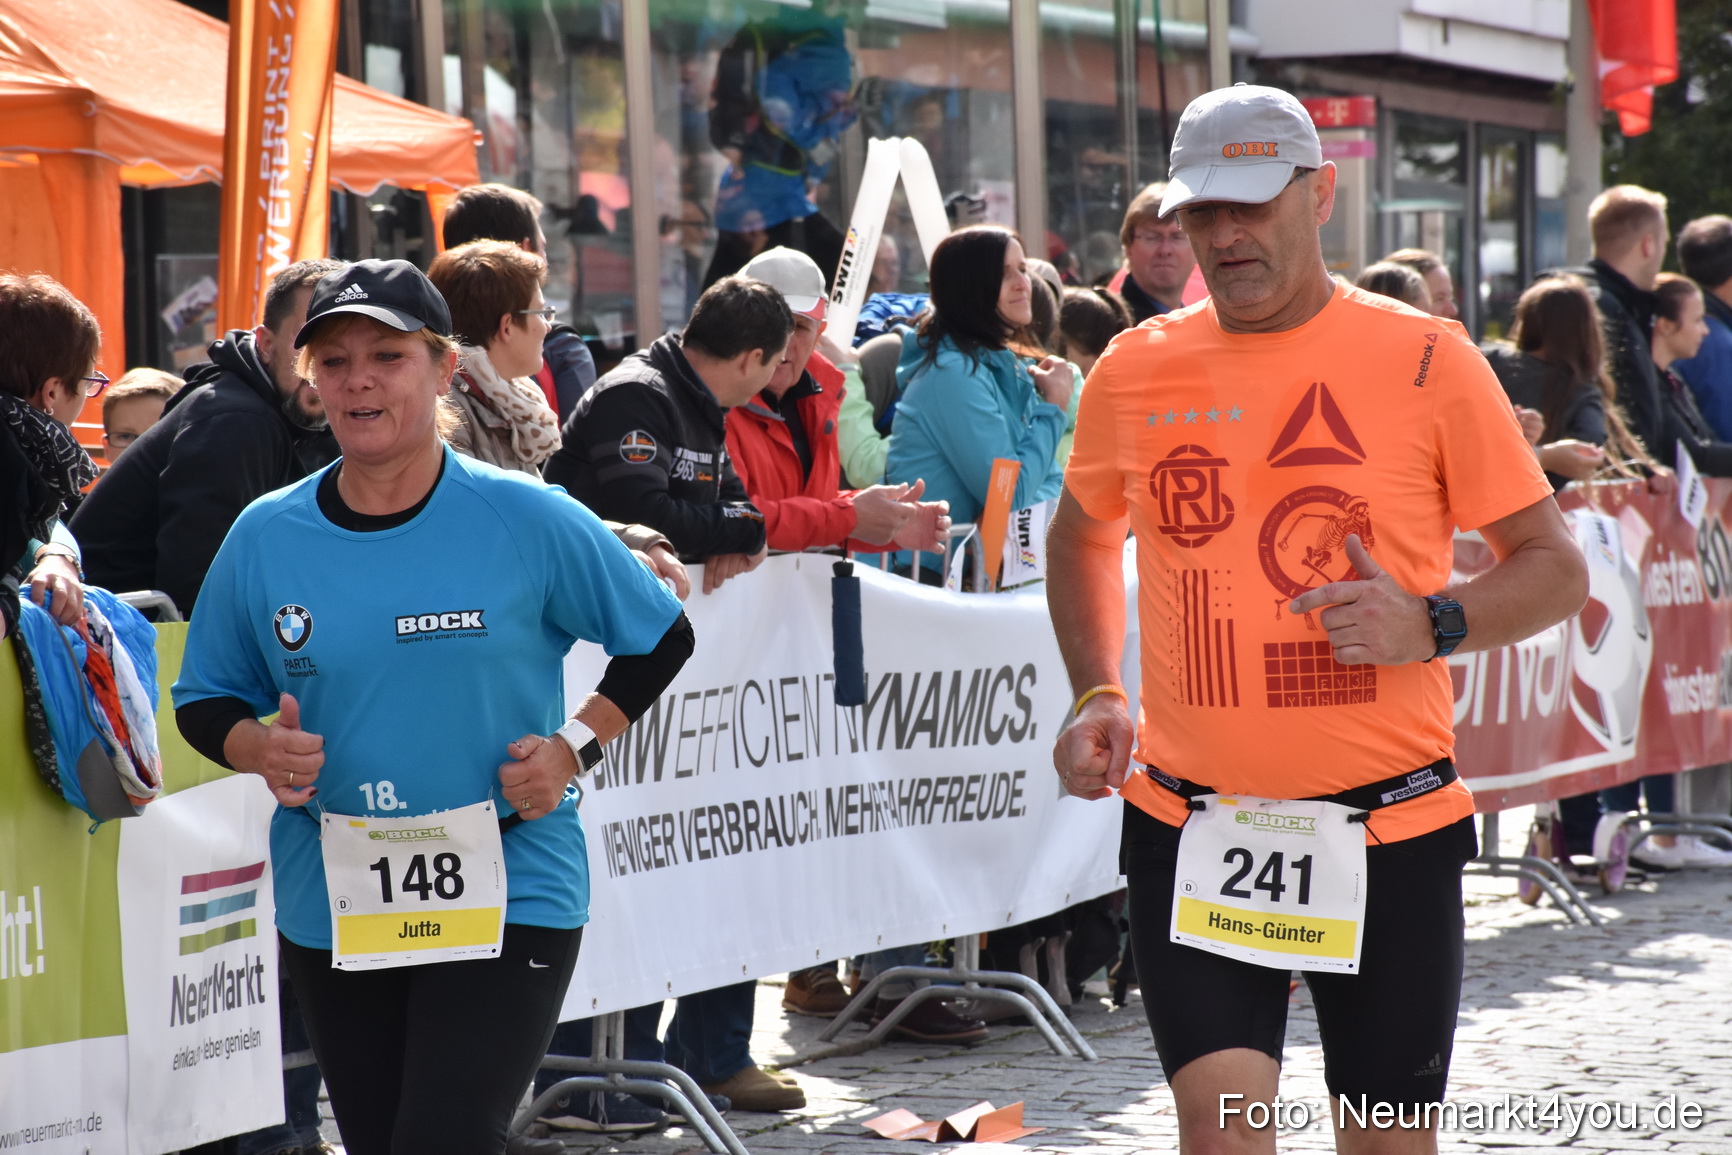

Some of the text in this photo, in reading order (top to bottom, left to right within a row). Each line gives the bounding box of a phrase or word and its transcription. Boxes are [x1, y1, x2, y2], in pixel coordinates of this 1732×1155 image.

[260, 36, 279, 180] PRINT
[266, 34, 292, 277] WERBUNG
[1223, 142, 1278, 158] OBI
[335, 291, 369, 303] adidas
[1414, 344, 1435, 388] Reebok
[1018, 508, 1032, 547] swn
[275, 606, 310, 623] BMW
[395, 609, 487, 636] BOCK
[396, 634, 423, 644] inspired
[425, 633, 433, 641] by
[458, 631, 489, 639] concepts
[283, 657, 316, 670] PARTL
[286, 669, 318, 679] Neumarkt
[594, 694, 677, 791] MW
[1409, 770, 1432, 784] beat
[358, 780, 408, 811] 18.
[1390, 778, 1441, 800] yesterday.
[1253, 812, 1316, 831] BOCK
[386, 826, 448, 840] BOCK
[601, 812, 679, 878] WENIGER
[370, 853, 465, 903] 148
[1220, 847, 1313, 905] 241
[1185, 883, 1192, 892] D
[340, 900, 347, 909] D
[398, 921, 441, 939] Jutta
[1208, 911, 1325, 943] Hans-Günter
